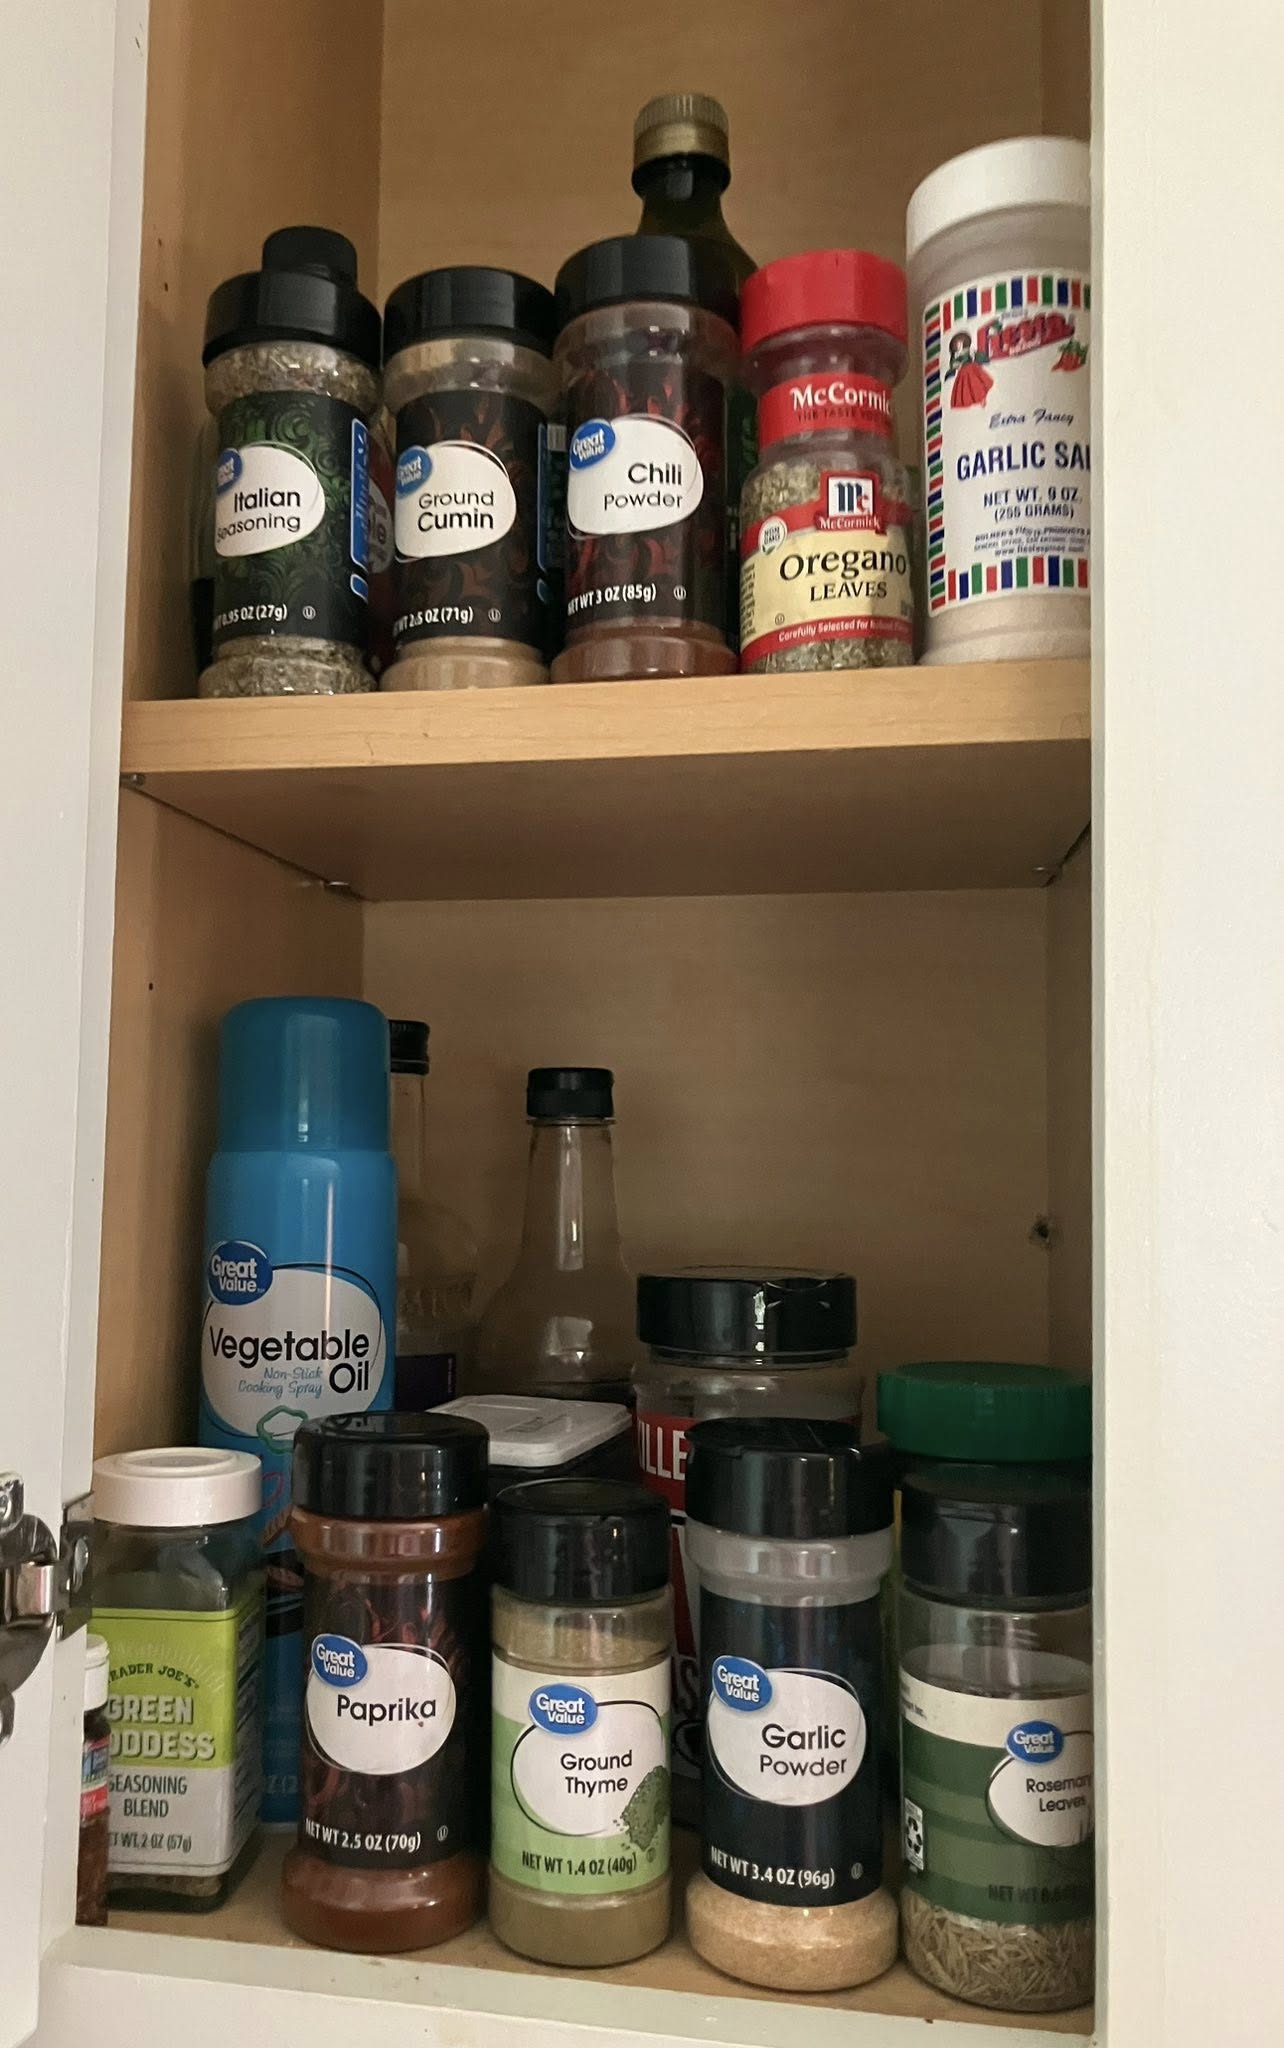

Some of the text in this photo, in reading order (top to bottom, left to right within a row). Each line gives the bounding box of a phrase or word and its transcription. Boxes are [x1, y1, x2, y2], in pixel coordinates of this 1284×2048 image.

[989, 408, 1074, 429] Extra Fancy
[957, 441, 1045, 481] GARLIC
[628, 463, 682, 485] Chili
[234, 487, 301, 513] Italian
[419, 490, 494, 510] Ground
[604, 491, 683, 511] Powder
[984, 488, 1009, 508] NET
[1047, 485, 1057, 501] 9
[418, 508, 494, 532] Cumin
[1025, 502, 1074, 520] GRAMS)
[819, 515, 881, 530] McCormick
[779, 550, 907, 581] Oregano
[580, 591, 594, 609] WT
[596, 589, 603, 605] 3
[604, 586, 621, 602] OZ
[622, 583, 657, 603] (85g)
[810, 581, 888, 602] LEAVES
[240, 606, 255, 621] OZ
[256, 603, 288, 622] (27g)
[425, 607, 440, 624] OZ
[441, 605, 474, 625] (71g)
[778, 625, 816, 642] Carefully
[818, 619, 855, 633] Selected
[856, 618, 868, 630] for
[211, 1254, 258, 1279] Great
[219, 1277, 258, 1293] Value
[210, 1326, 370, 1369] Vegetable
[263, 1366, 323, 1380] Non-Stick
[329, 1360, 369, 1394] Oil
[238, 1380, 323, 1400] Cooking Spray
[316, 1643, 356, 1668] Great
[108, 1662, 196, 1688] RADER JOE'S
[323, 1661, 356, 1679] Value
[716, 1665, 760, 1692] Great
[536, 1692, 586, 1715] Great
[725, 1684, 761, 1703] Value
[103, 1695, 194, 1725] GREEN
[337, 1694, 437, 1727] Paprika
[546, 1711, 586, 1725] Value
[109, 1729, 216, 1760] ODDESS
[761, 1723, 847, 1750] Garlic
[1013, 1730, 1055, 1746] Great
[1023, 1743, 1056, 1754] Value
[560, 1749, 633, 1771] Ground
[759, 1754, 848, 1776] Powder
[109, 1774, 188, 1796] SEASONING
[565, 1776, 629, 1799] Thyme
[123, 1798, 170, 1819] BLEND
[1039, 1795, 1087, 1813] Leaves
[141, 1832, 148, 1849] 2
[151, 1833, 165, 1849] OZ
[305, 1818, 422, 1854] NET WT 2.5 OZ (70g)
[522, 1850, 638, 1878] NET WT 1.4 OZ (40g)
[710, 1845, 836, 1890] NET WT 3.4 OZ (96g)
